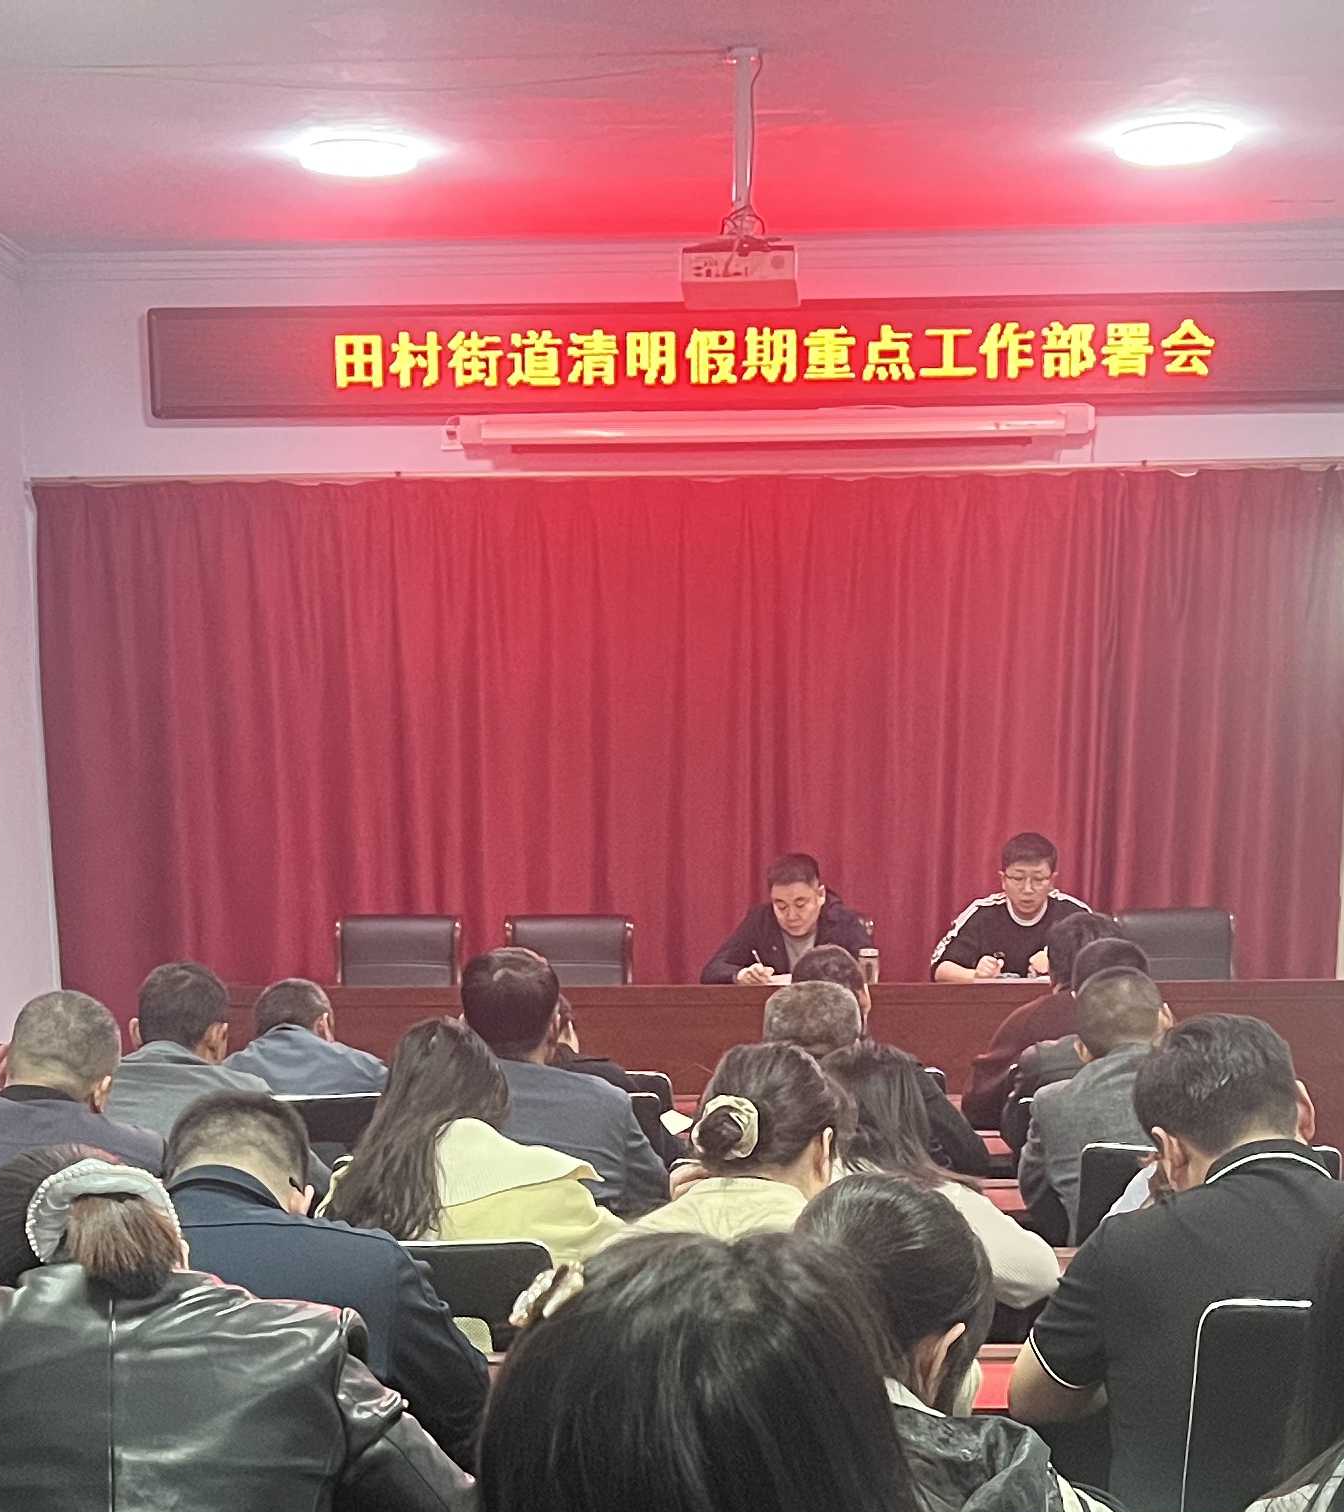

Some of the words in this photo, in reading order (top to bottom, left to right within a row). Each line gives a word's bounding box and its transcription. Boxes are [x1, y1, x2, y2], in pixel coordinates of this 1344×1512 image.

[334, 318, 1216, 389] 田村街道清明假期重点工作部署会
